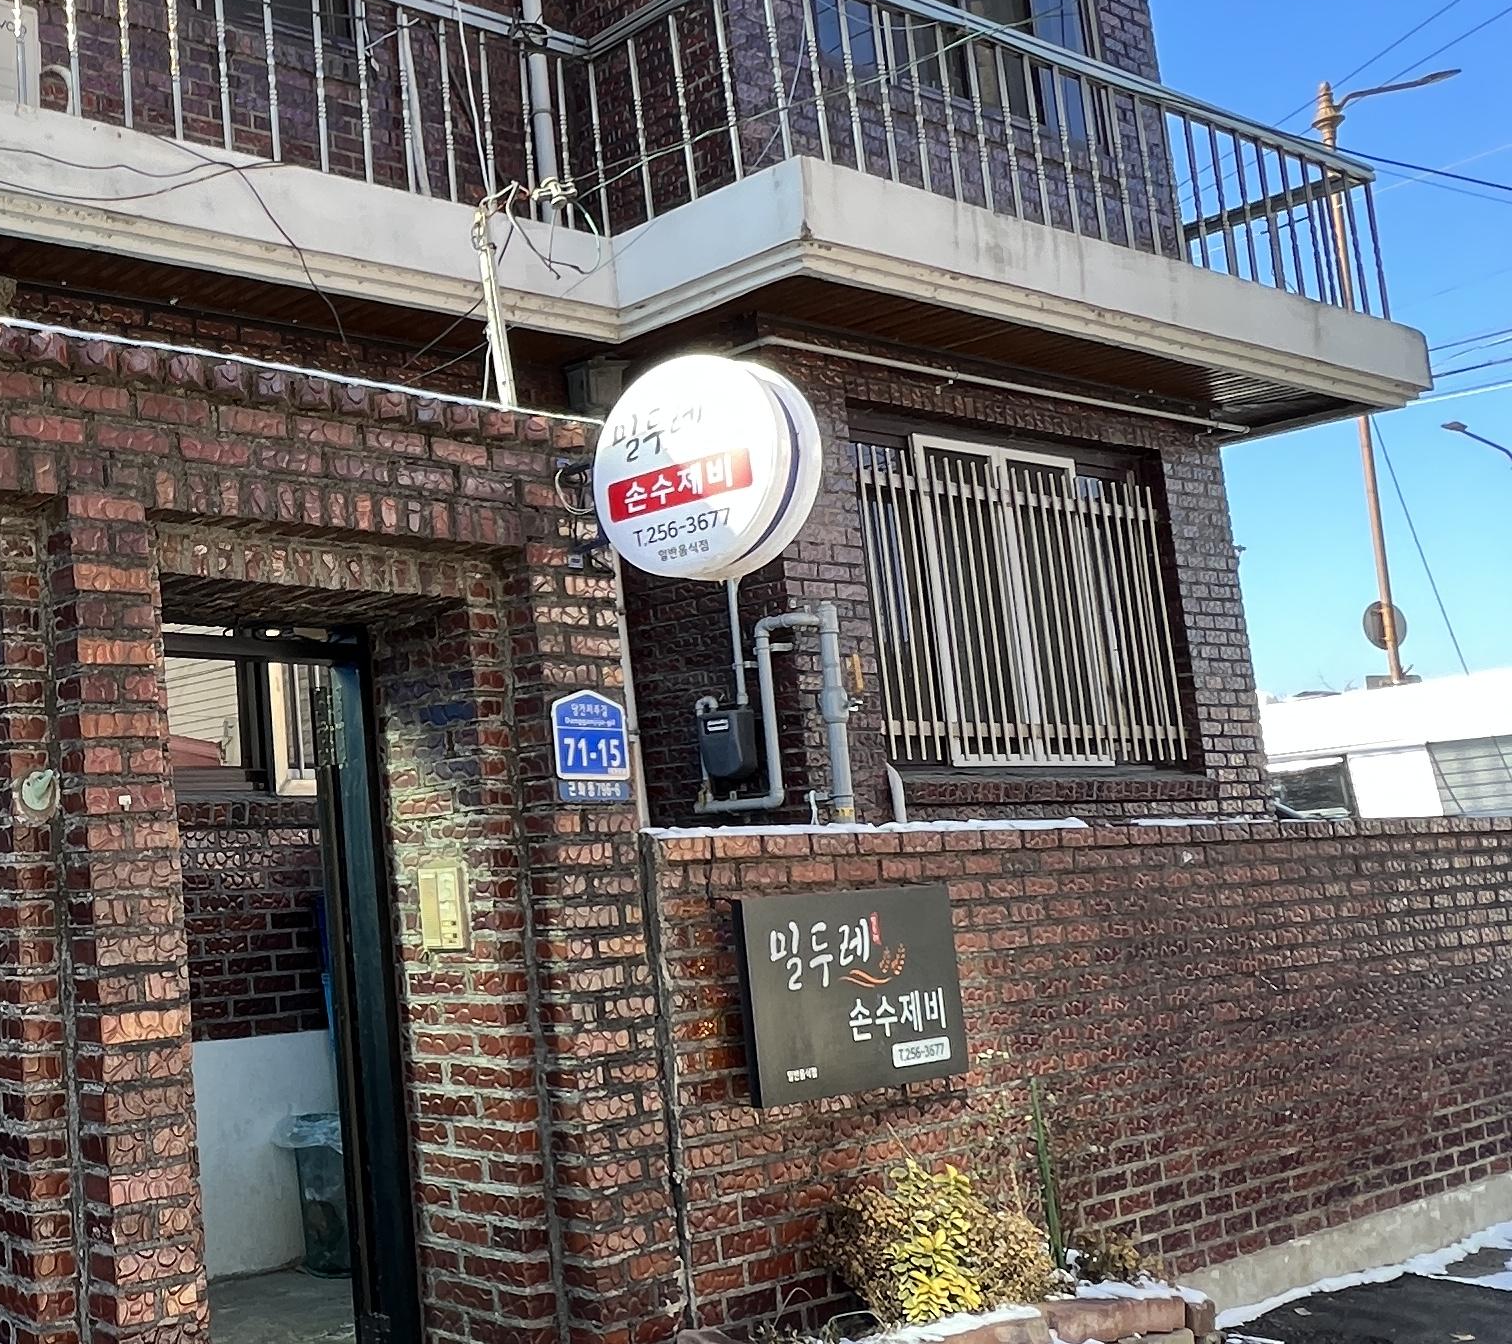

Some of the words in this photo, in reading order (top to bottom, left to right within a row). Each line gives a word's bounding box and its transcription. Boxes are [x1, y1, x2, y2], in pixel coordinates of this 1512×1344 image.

[624, 453, 734, 514] 손수제비
[632, 507, 730, 548] T.256-3677
[563, 737, 622, 767] 71-15
[769, 917, 871, 991] 밀두레
[848, 986, 947, 1042] 손수제비
